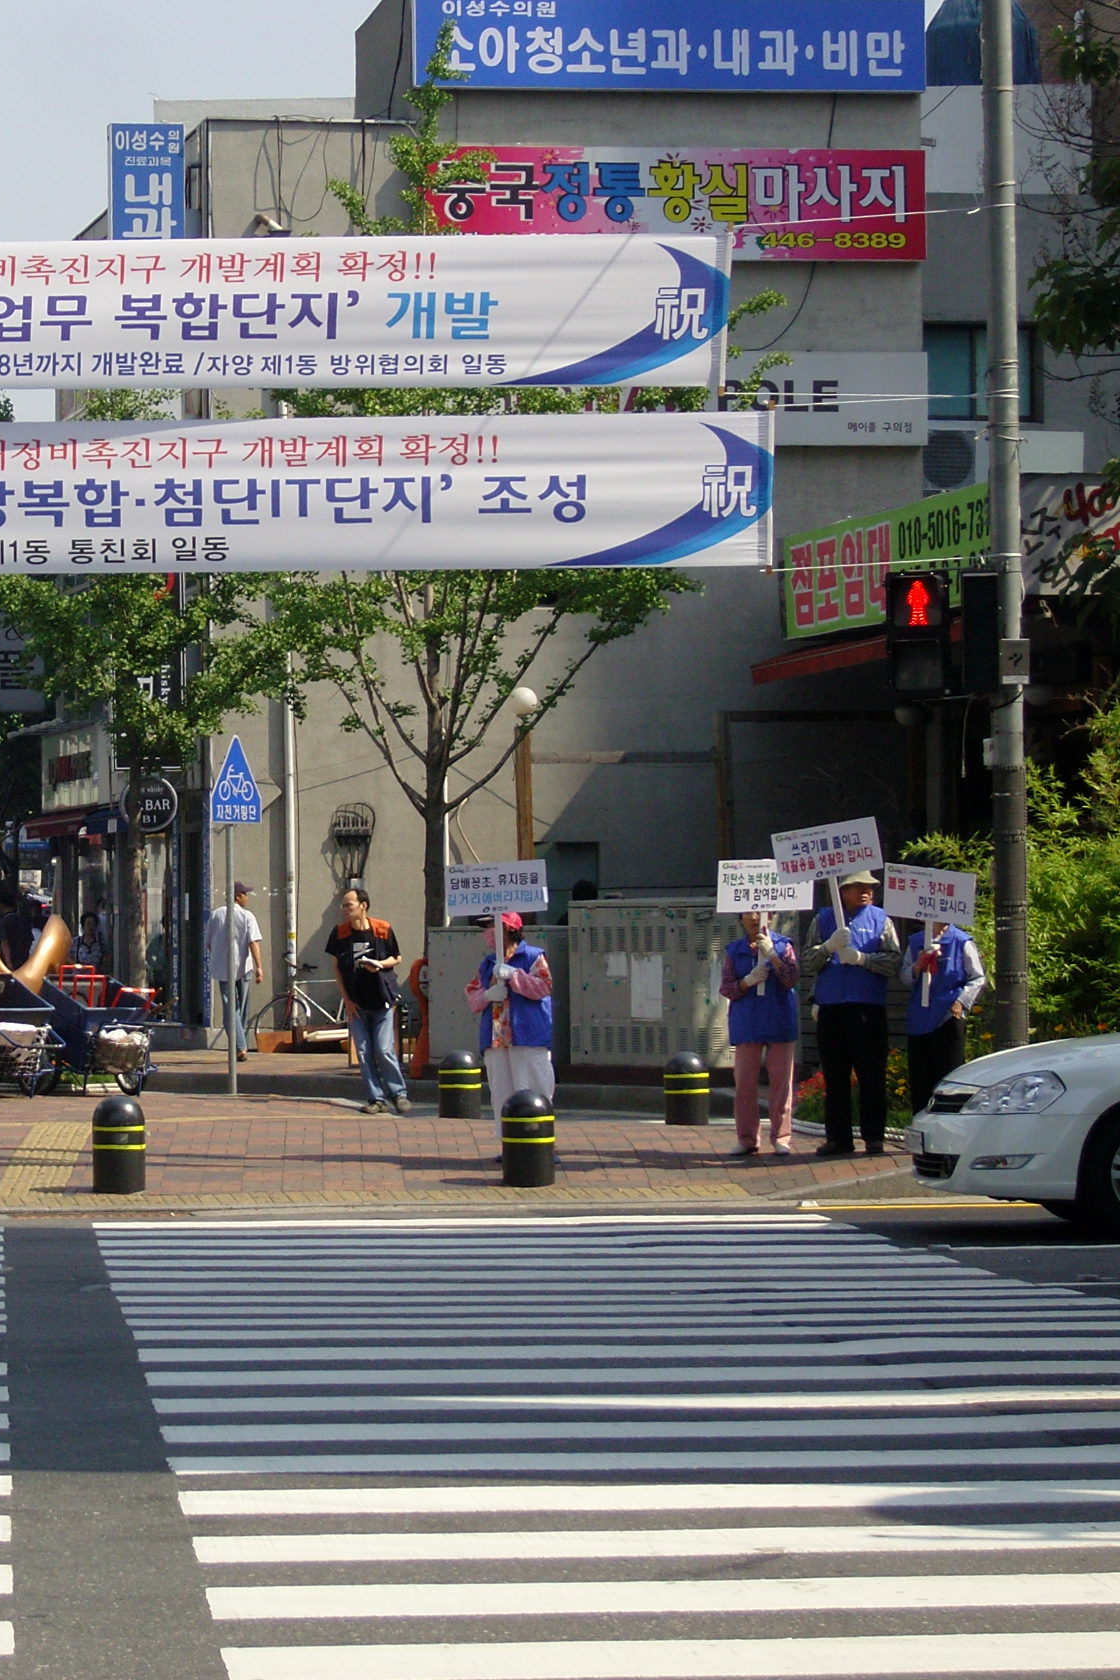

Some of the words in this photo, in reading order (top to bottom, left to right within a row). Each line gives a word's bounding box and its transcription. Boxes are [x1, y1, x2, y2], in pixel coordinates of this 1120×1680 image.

[441, 0, 557, 17] 이성수의원
[115, 130, 165, 151] 이성수
[167, 130, 180, 154] 의원
[124, 156, 172, 167] 진료과목
[121, 172, 178, 239] 내과
[760, 231, 907, 249] 446-8389
[180, 251, 323, 284] 개발계획
[337, 250, 437, 282] 확정!!
[114, 290, 360, 341] 복합단지’
[385, 291, 499, 341] 개발
[653, 286, 710, 341] 祝
[91, 351, 185, 376] 개발완료
[260, 353, 316, 377] 제1동
[330, 353, 448, 376] 방위협의회
[461, 353, 507, 376] 일동
[717, 379, 839, 413] POLE
[882, 421, 913, 434] 구의점
[242, 434, 383, 468] 개발계획
[399, 433, 498, 466] 확정!!
[478, 474, 587, 524] 조성
[702, 463, 758, 519] 祝
[898, 497, 991, 559] 010-5016-73
[67, 537, 158, 565] 통친회
[171, 536, 230, 562] 일동
[789, 521, 891, 629] 점포임대
[216, 804, 257, 821] 자전거횡단
[791, 838, 829, 857] 쓰레기를
[498, 872, 539, 886] 휴지등을
[722, 872, 745, 886] 저탄소
[747, 872, 780, 886] 녹색생활
[733, 888, 750, 901] 함께
[918, 896, 936, 910] 하지
